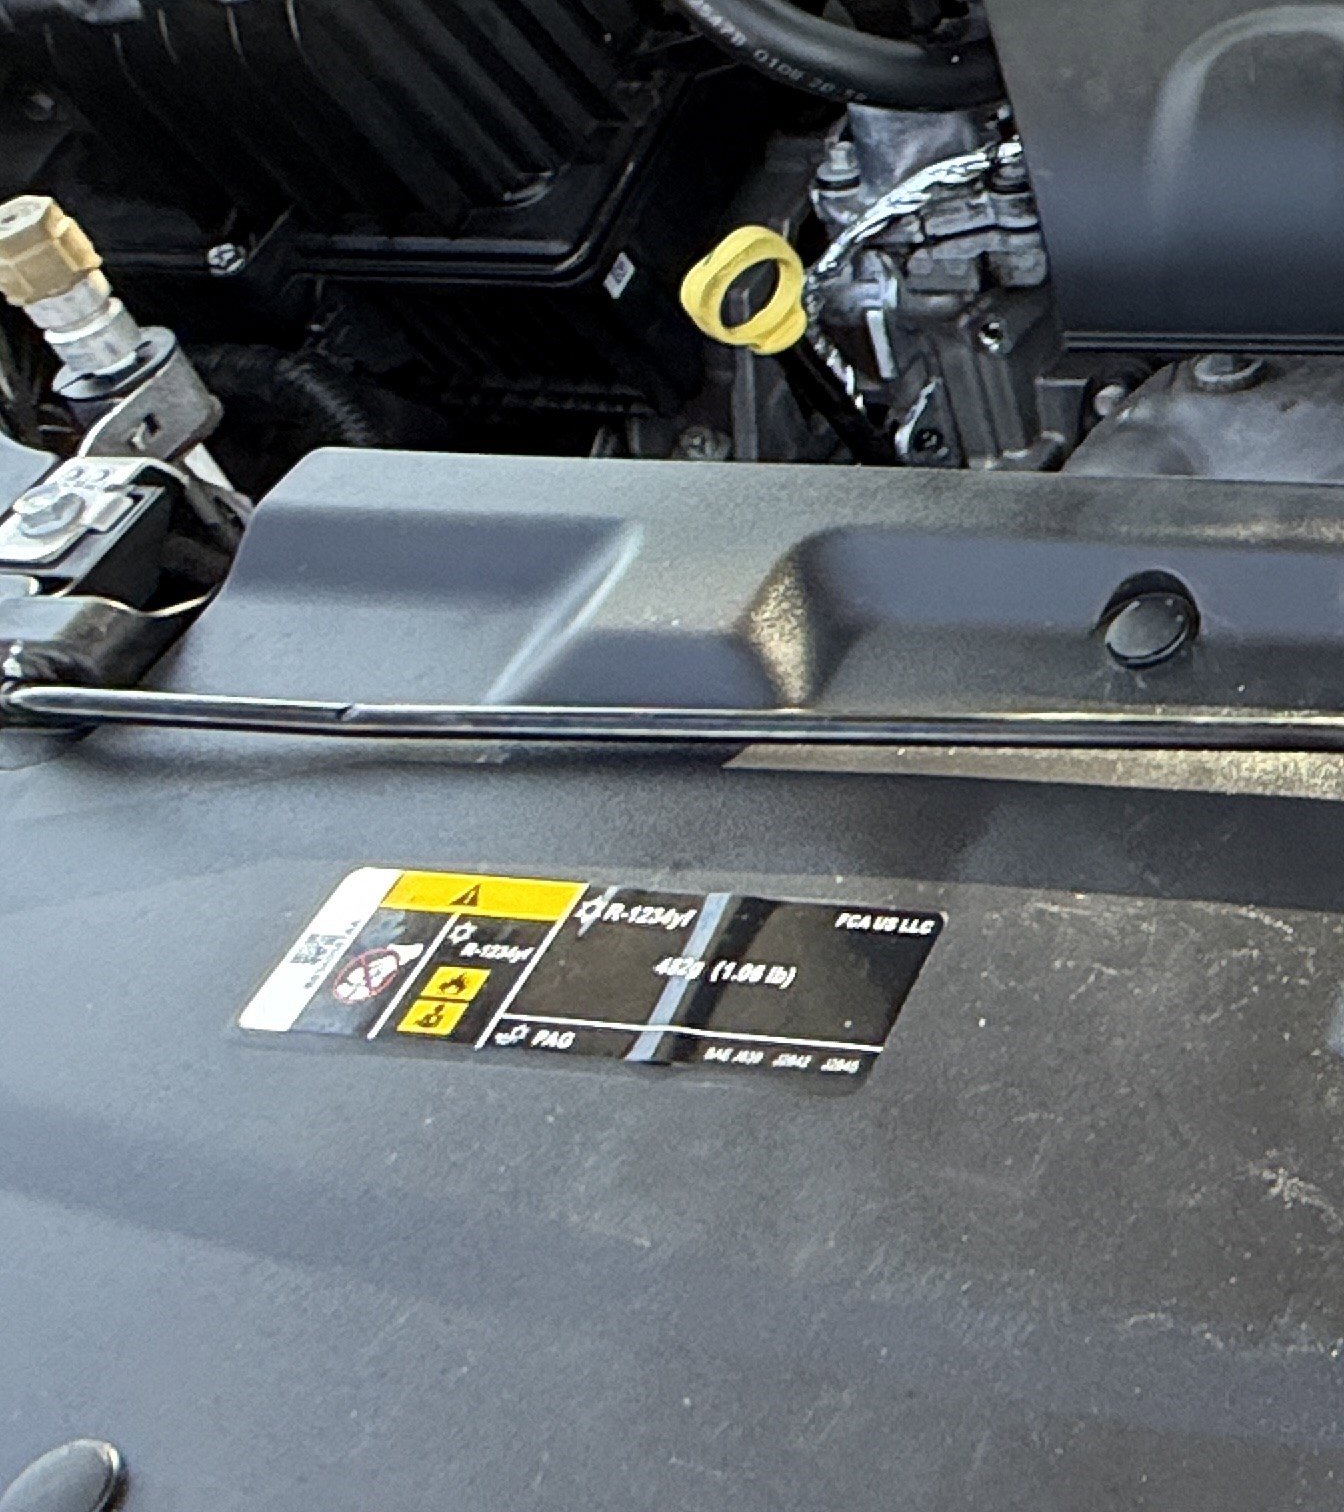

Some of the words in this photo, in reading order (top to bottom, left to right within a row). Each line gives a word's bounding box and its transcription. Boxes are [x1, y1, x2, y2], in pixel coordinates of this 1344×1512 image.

[602, 901, 698, 931] R-1234yf
[835, 912, 872, 930] FCA
[873, 916, 900, 932] US
[898, 918, 936, 936] LLC
[458, 941, 536, 964] R-1234yf
[530, 1028, 576, 1049] PAG
